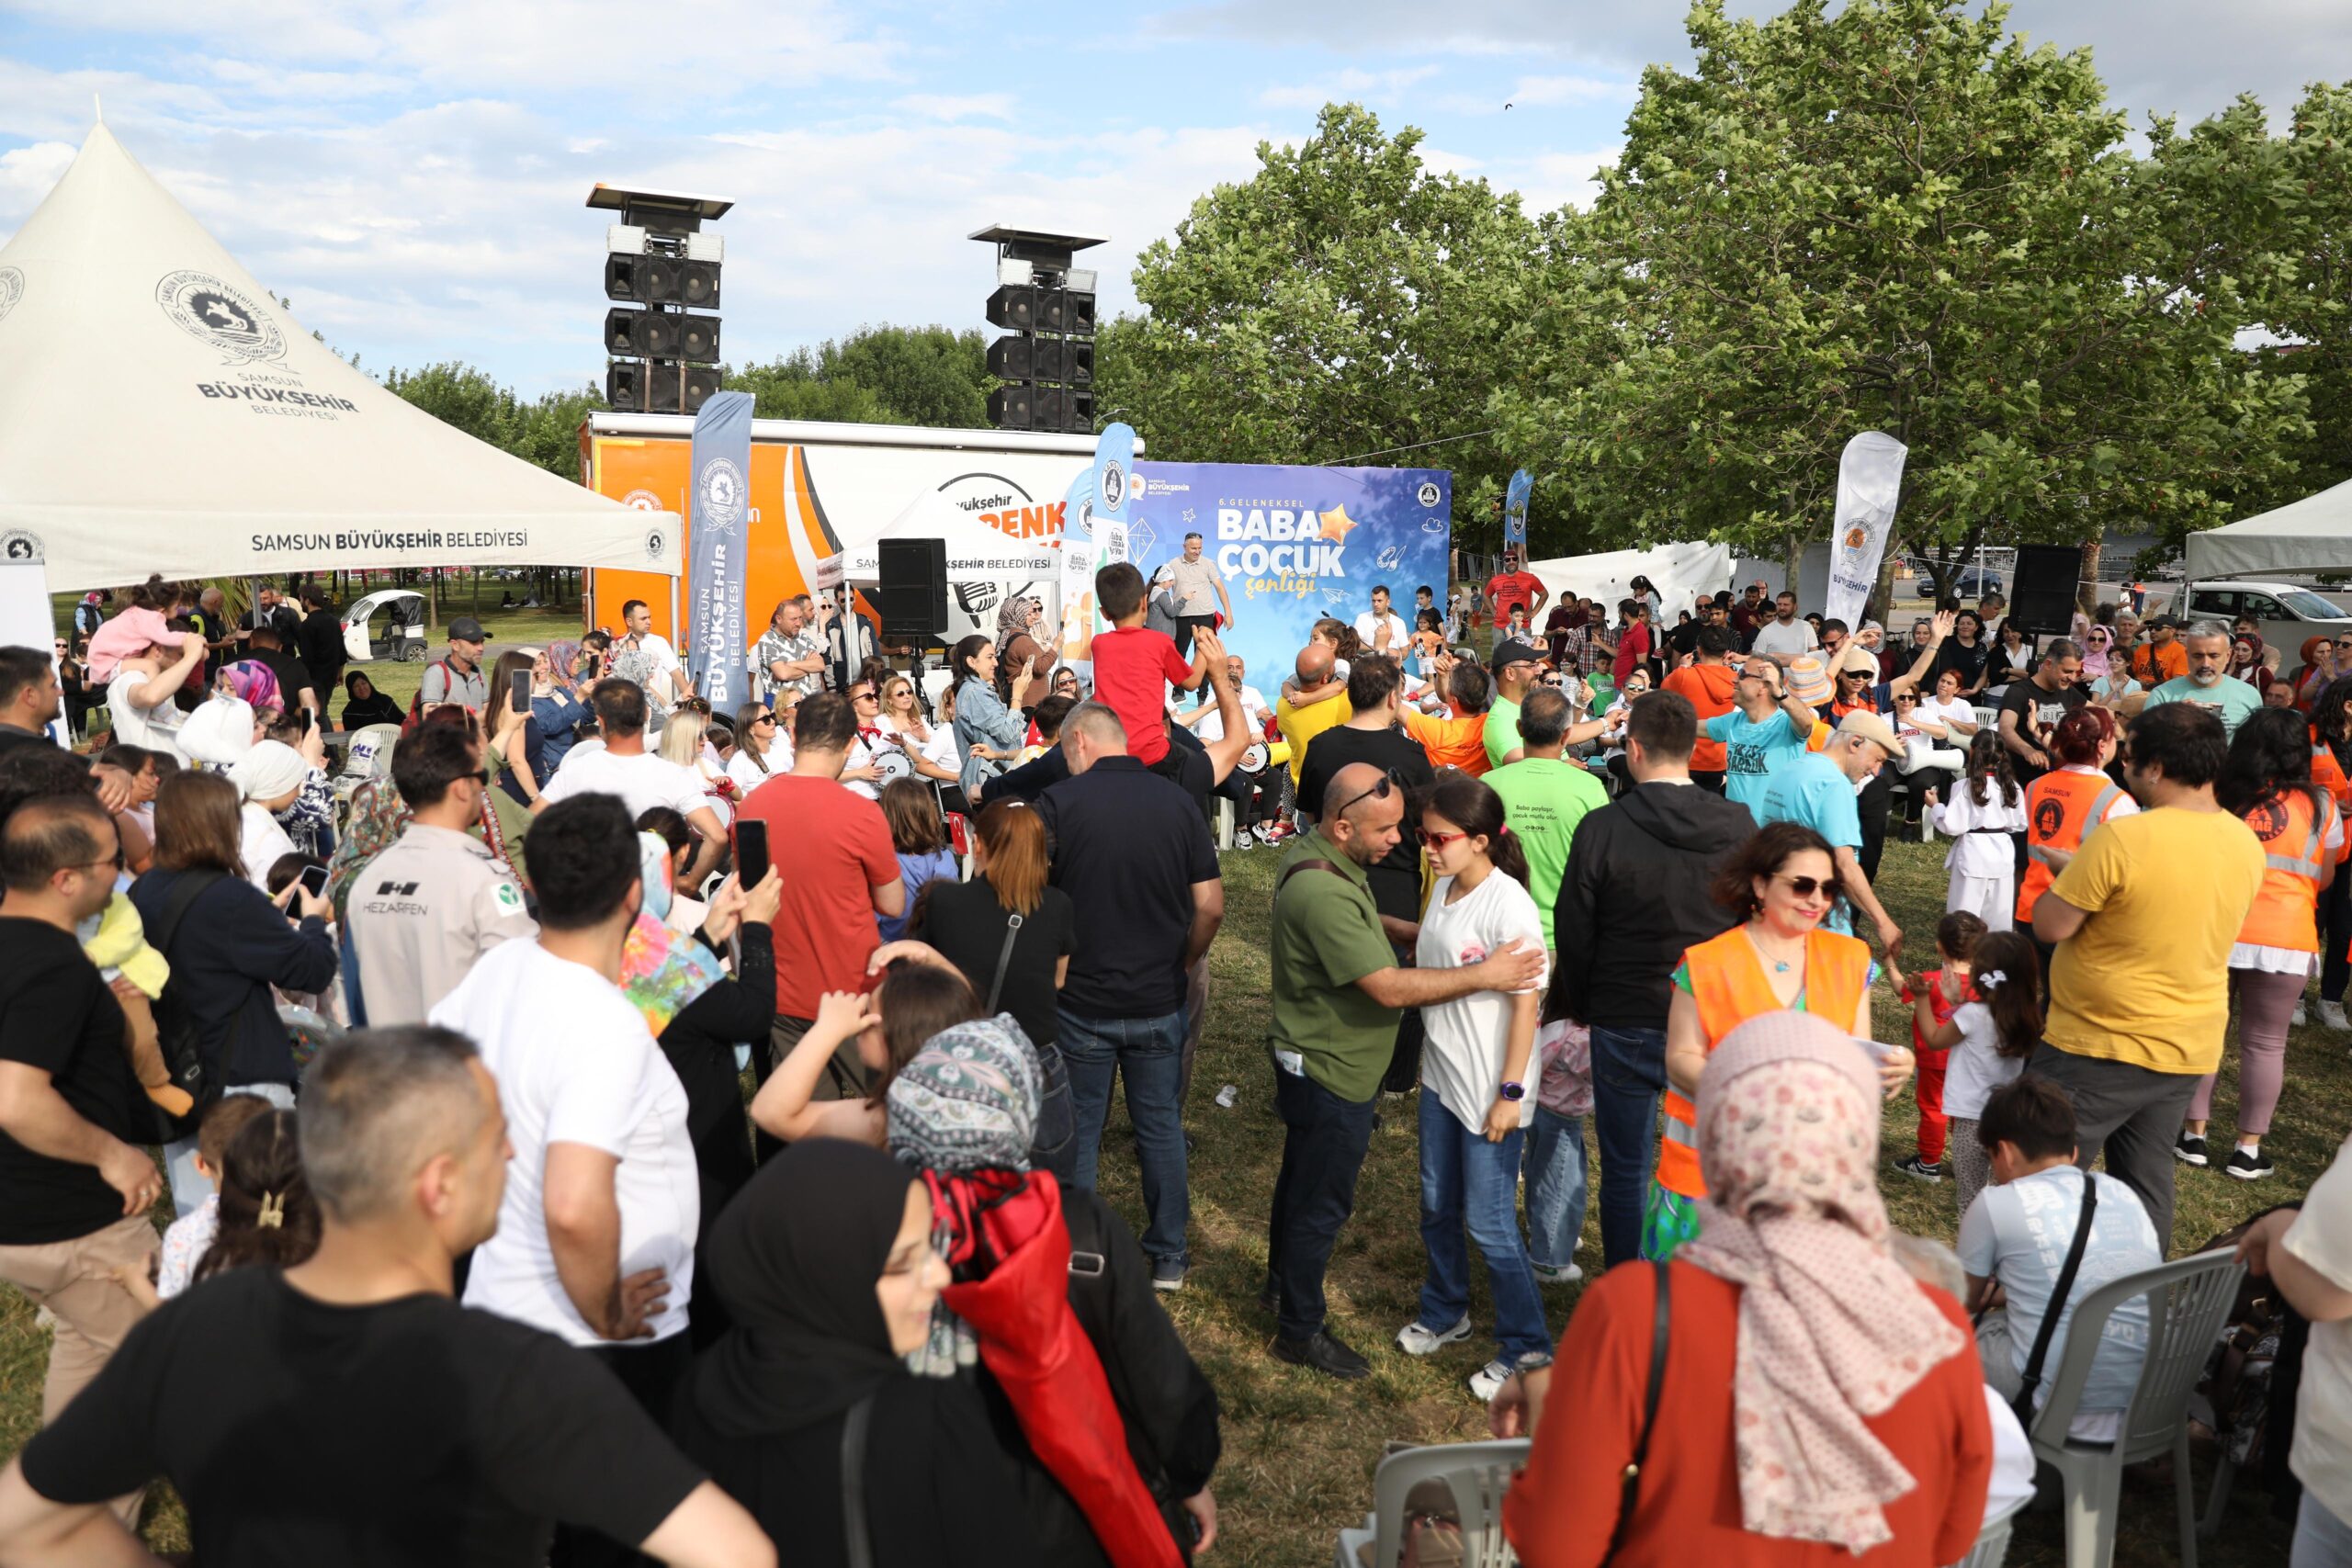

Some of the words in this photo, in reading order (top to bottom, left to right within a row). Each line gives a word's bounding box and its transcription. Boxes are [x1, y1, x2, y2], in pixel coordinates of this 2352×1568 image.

[236, 371, 304, 388] SAMSUN
[196, 380, 361, 412] BÜYÜKŞEHİR
[251, 404, 339, 421] BELEDİYESİ
[1148, 483, 1191, 492] BÜYÜKŞEHİR
[1218, 498, 1227, 506] 6.
[1229, 499, 1305, 508] GELENEKSEL
[1217, 508, 1323, 542] BABA
[251, 534, 332, 551] SAMSUN
[335, 529, 443, 552] BÜYÜKŞEHİR
[447, 527, 528, 547] BELEDİYESİ
[856, 558, 881, 569] SAM
[987, 557, 1051, 570] BELEDİYESİ
[1217, 543, 1347, 582] ÇOCUK
[1245, 569, 1318, 601] şenliği
[700, 588, 710, 654] SAMSUN
[707, 544, 728, 703] BÜYÜKŞEHİR
[727, 580, 741, 667] BELEDİYESİ
[2043, 786, 2072, 797] SAMSUN
[362, 900, 428, 916] HEZARFEN
